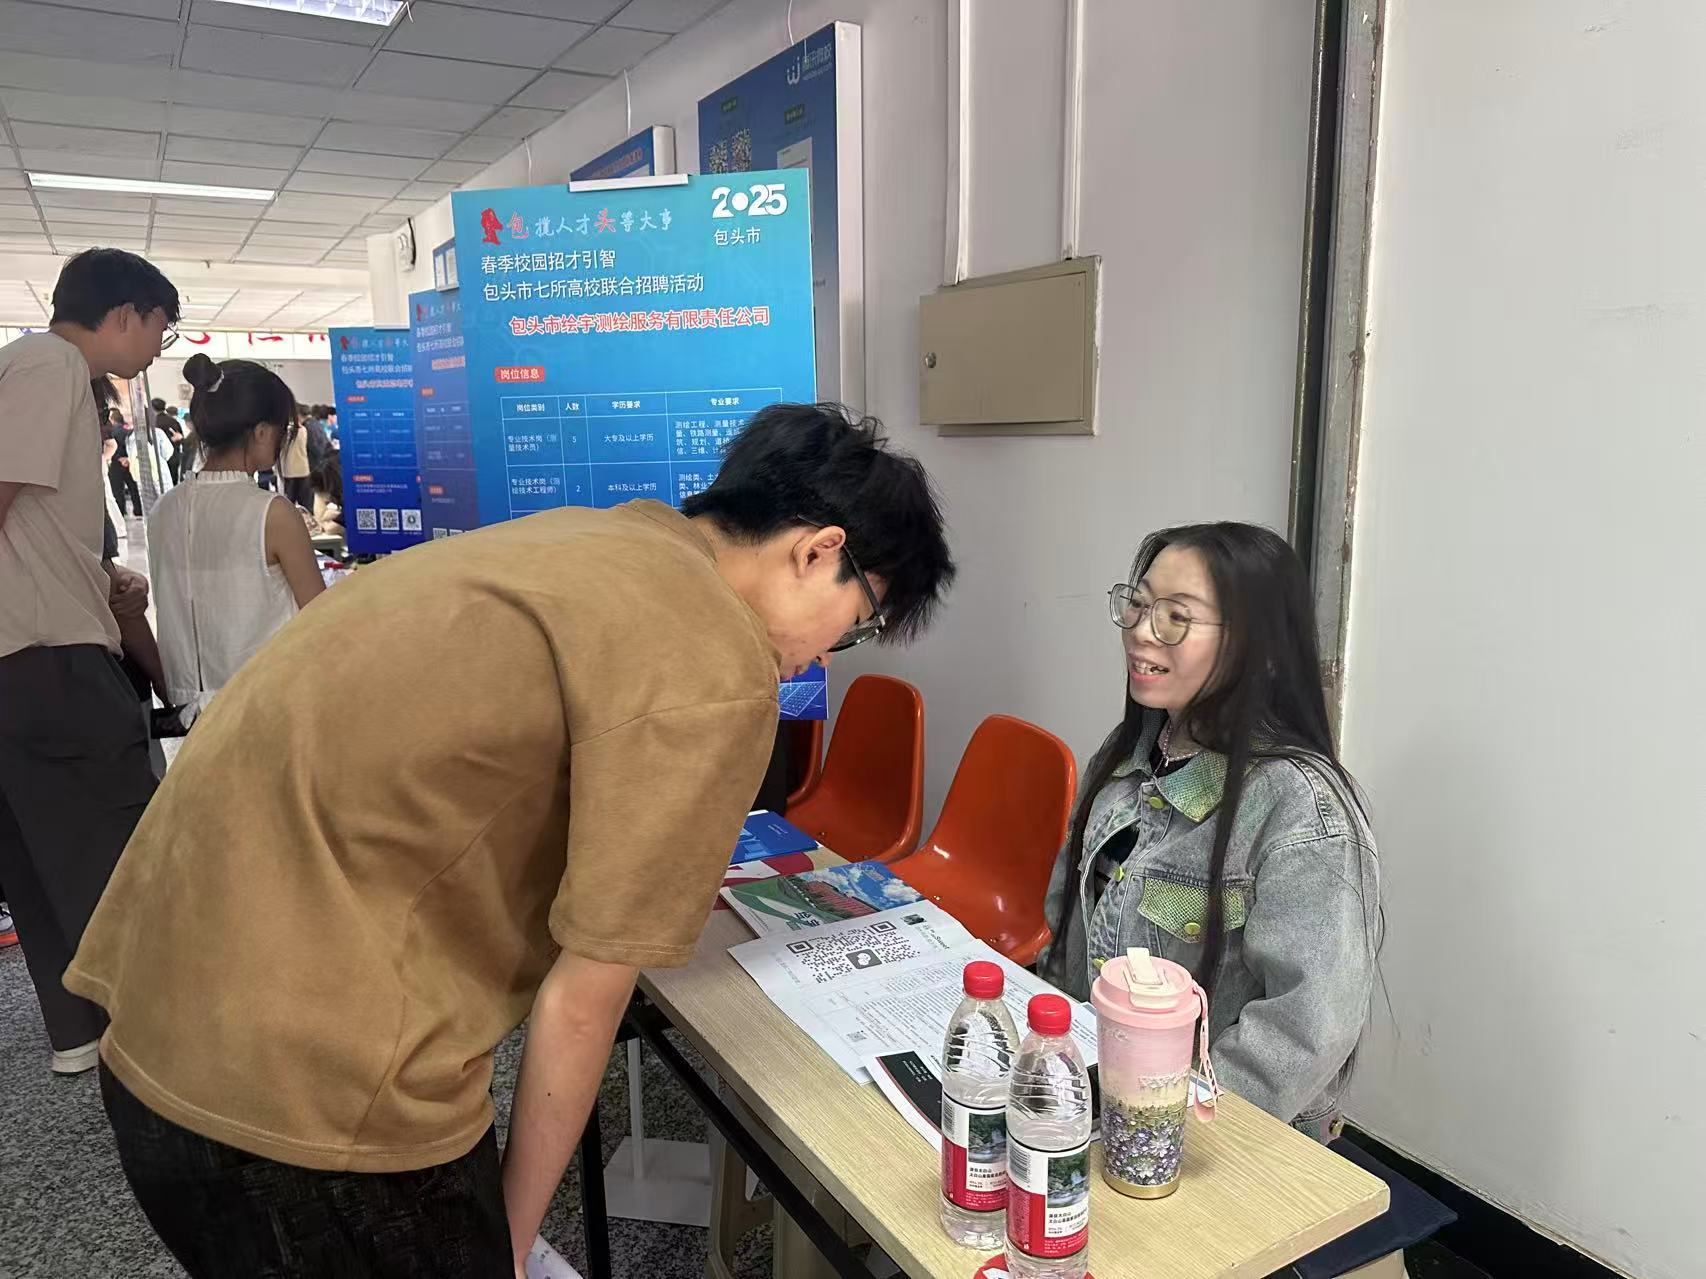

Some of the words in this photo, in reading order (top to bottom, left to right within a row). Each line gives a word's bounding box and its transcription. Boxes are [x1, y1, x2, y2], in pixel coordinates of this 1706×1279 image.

[711, 183, 788, 219] 2025
[713, 227, 761, 246] 包头市
[481, 249, 616, 275] 春季校园招才引智
[483, 273, 705, 302] 包头市七所高校联合招聘活动
[510, 306, 771, 336] 包头市绘宇测绘服务有限责任公司
[500, 368, 540, 380] 岗位信息
[612, 401, 641, 409] 学历要求
[711, 397, 740, 406] 专业要求
[516, 403, 545, 412] 岗位类别
[565, 403, 580, 411] 人数
[572, 435, 577, 443] 5
[603, 433, 654, 442] 大专及以上学历
[576, 485, 581, 493] 2
[607, 483, 657, 492] 本科及以上学历
